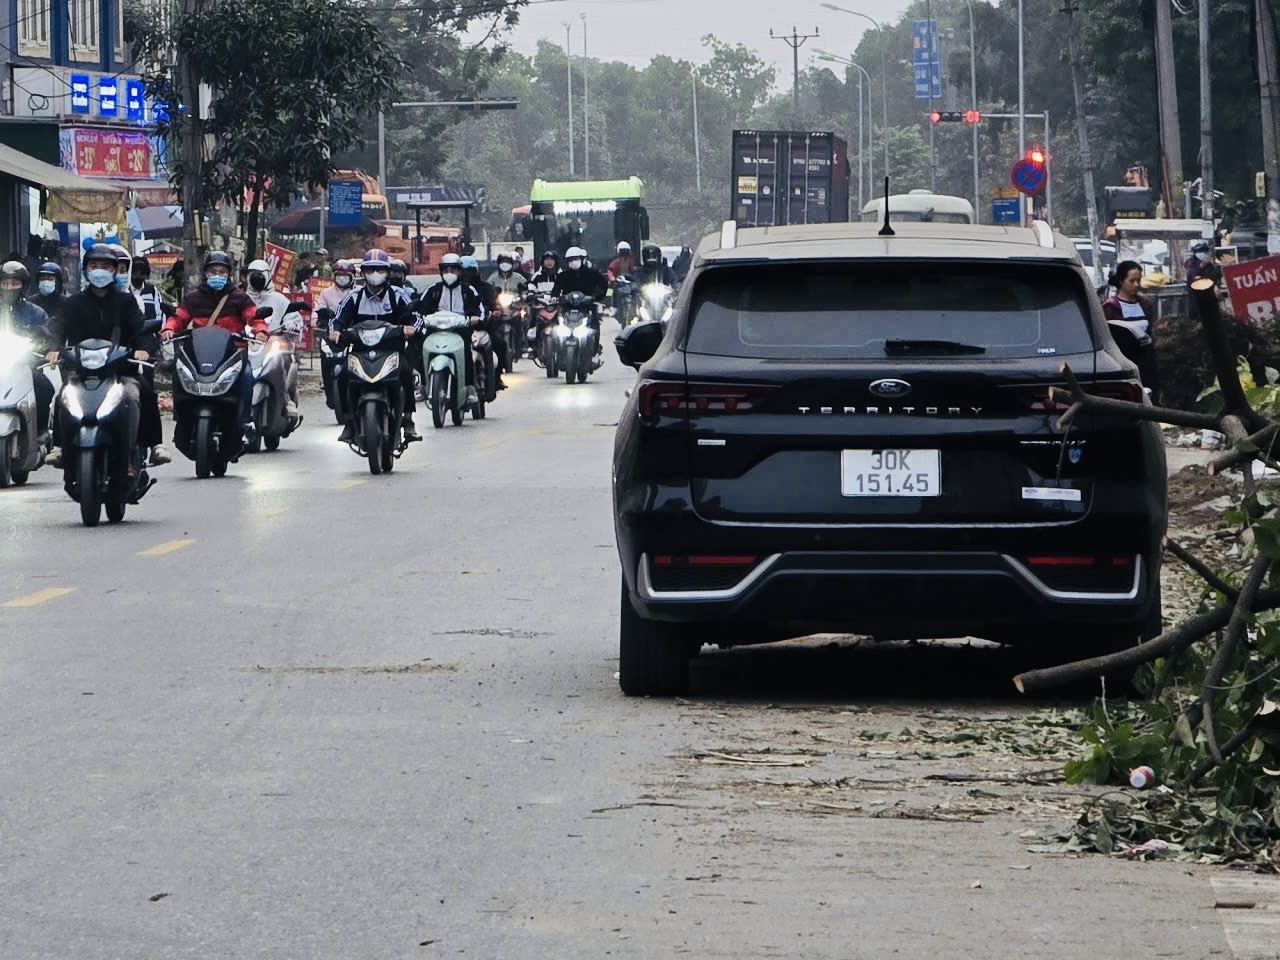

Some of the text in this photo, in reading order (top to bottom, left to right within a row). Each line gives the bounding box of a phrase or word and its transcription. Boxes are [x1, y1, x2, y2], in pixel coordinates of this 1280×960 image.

[1233, 265, 1278, 289] TUẤN
[1246, 296, 1280, 329] B
[878, 381, 902, 393] Ford
[798, 405, 983, 415] TERRITORY
[871, 449, 912, 471] 30K
[856, 473, 930, 493] 151.45
